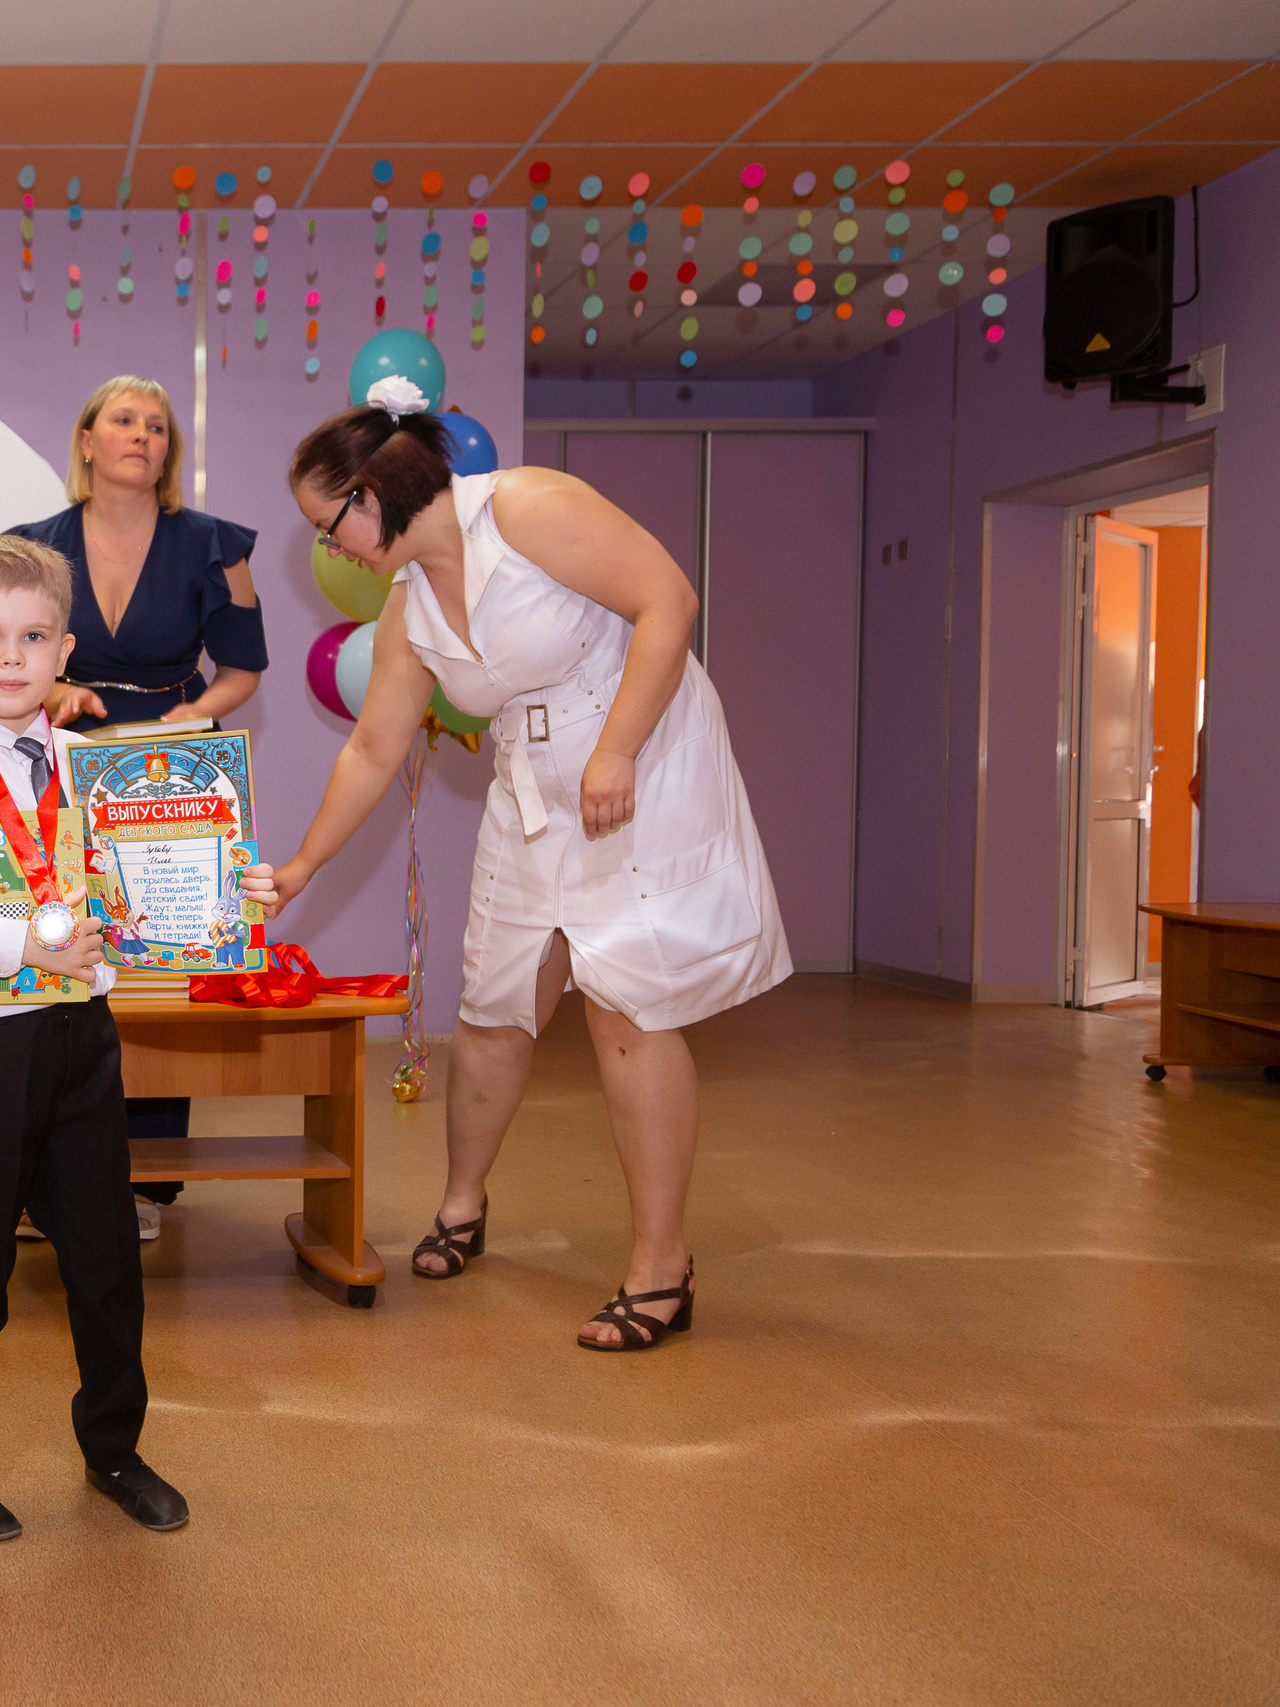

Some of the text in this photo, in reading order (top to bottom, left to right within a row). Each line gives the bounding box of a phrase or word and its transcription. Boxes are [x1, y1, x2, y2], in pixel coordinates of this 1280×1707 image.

[107, 800, 218, 821] ВЫПУСКНИКУ
[118, 822, 213, 838] ДЕТСКОГО САДА
[143, 865, 199, 875] В новый мир
[132, 876, 180, 886] открылась
[144, 885, 157, 894] До
[140, 893, 208, 903] детский садик!
[149, 913, 204, 923] тебя теперь
[176, 922, 209, 930] книжки
[161, 931, 202, 941] тетради!
